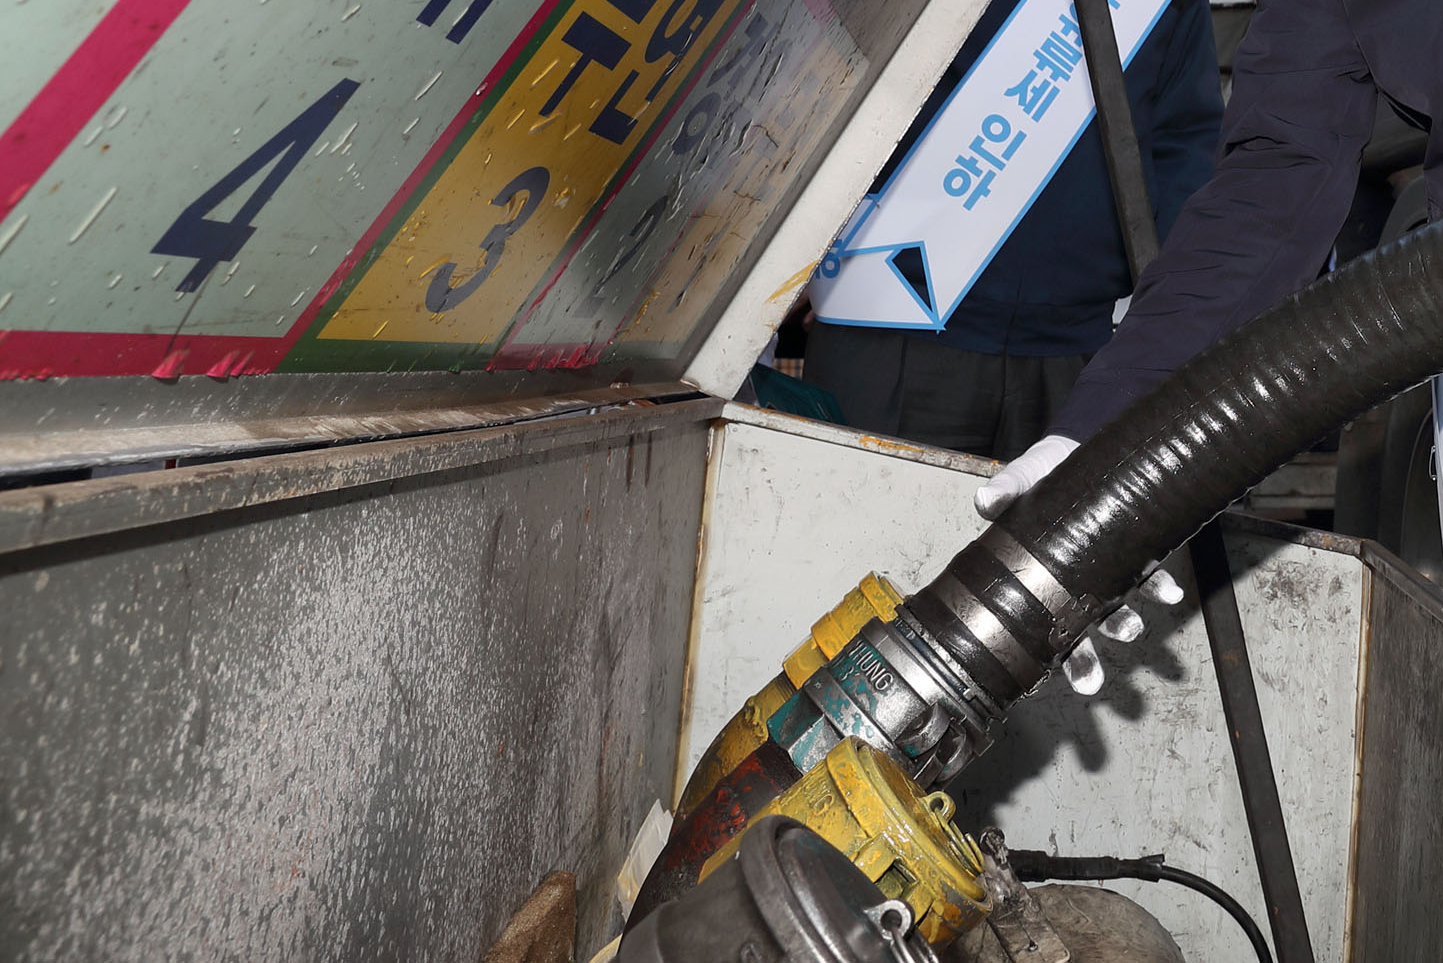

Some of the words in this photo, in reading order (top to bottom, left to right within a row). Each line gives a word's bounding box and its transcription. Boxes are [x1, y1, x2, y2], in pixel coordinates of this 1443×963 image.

[150, 77, 362, 293] 4
[942, 113, 1028, 211] 인하
[425, 166, 550, 314] 3
